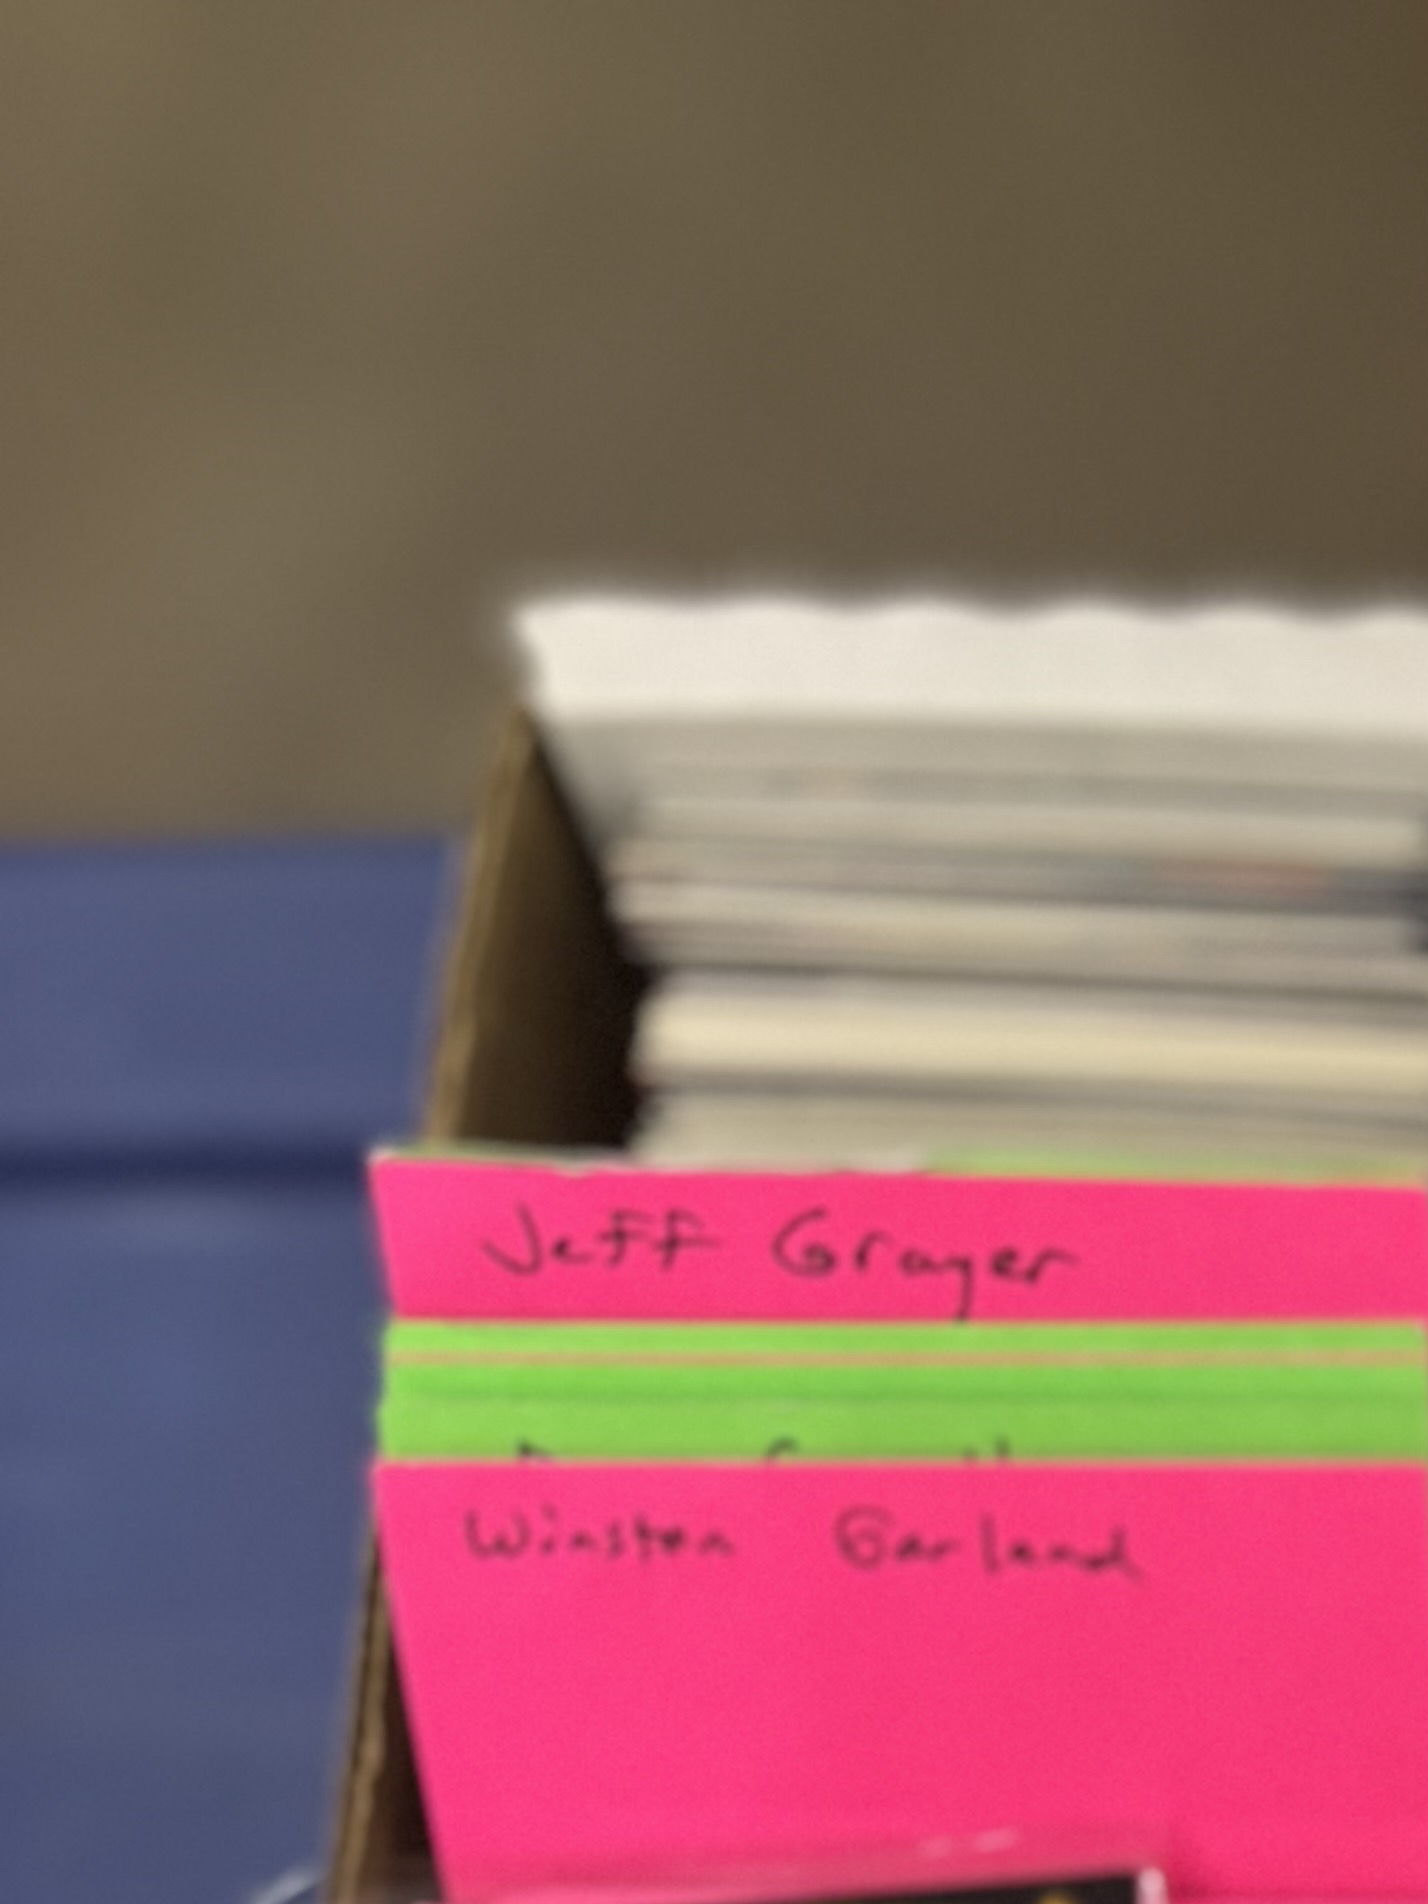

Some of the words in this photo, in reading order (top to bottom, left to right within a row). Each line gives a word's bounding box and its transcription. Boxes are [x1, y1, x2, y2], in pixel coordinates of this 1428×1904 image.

[482, 1203, 720, 1272] Jeff
[772, 1207, 1078, 1322] Grayer
[463, 1502, 738, 1564] Winston
